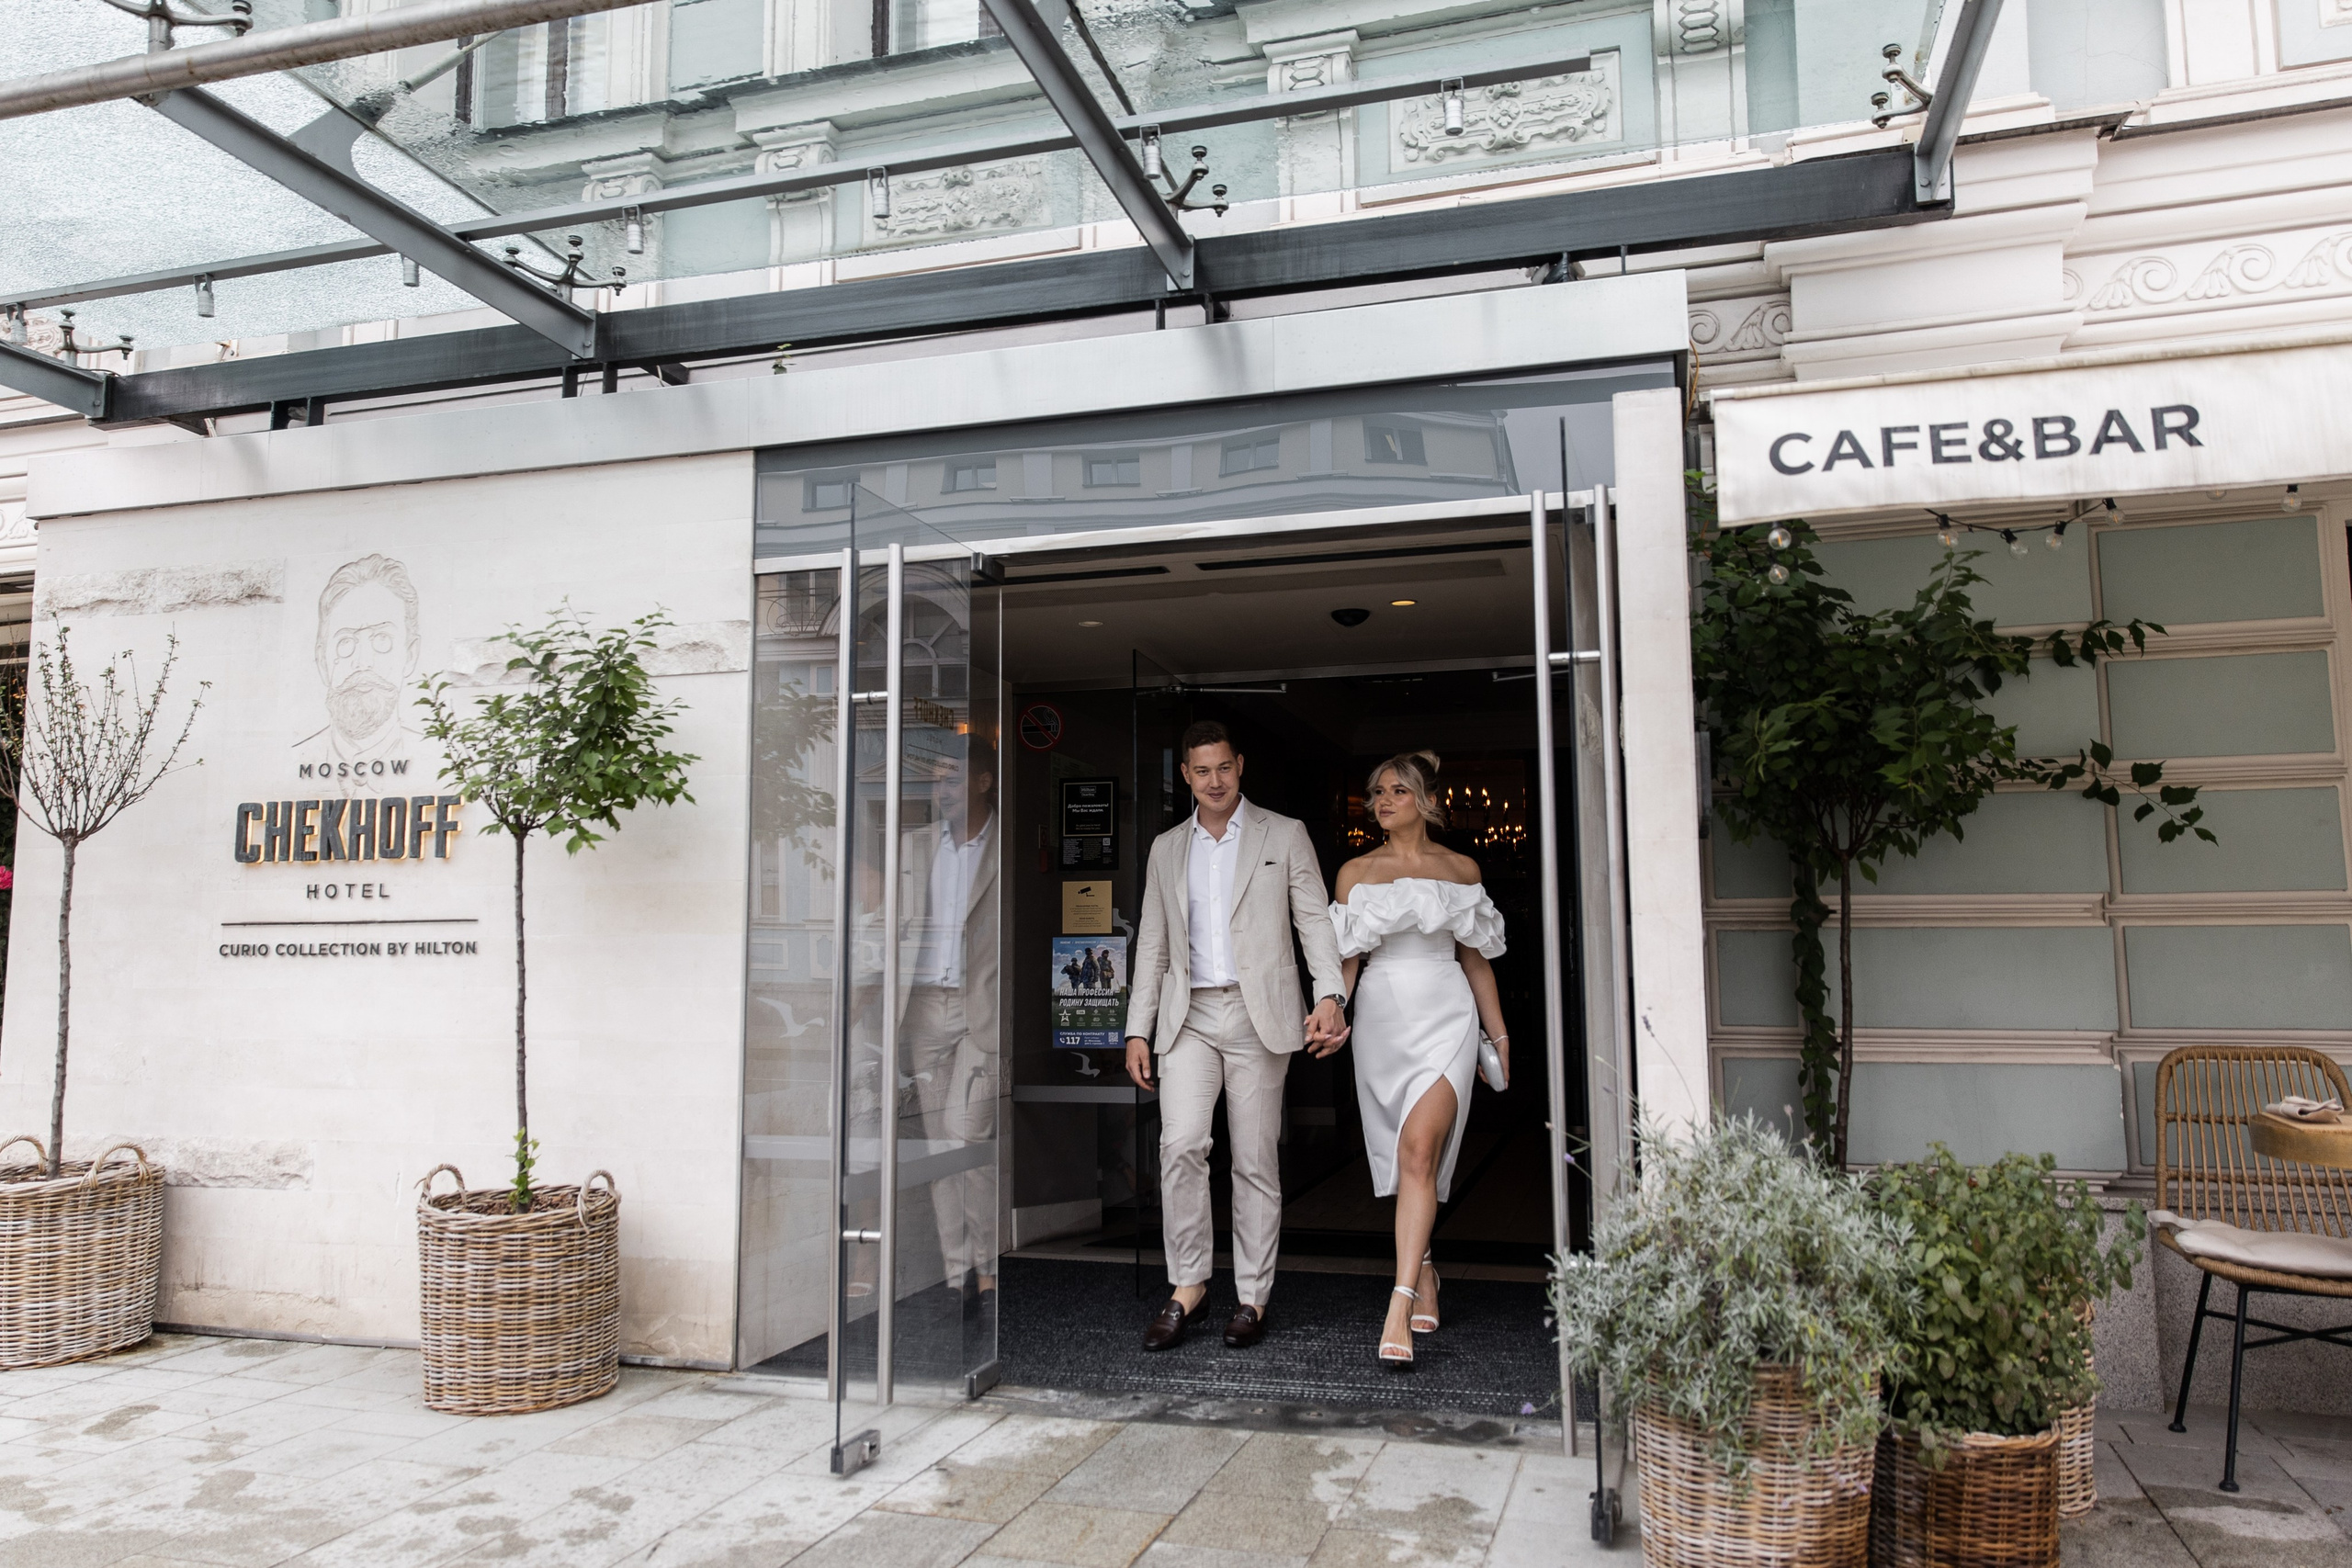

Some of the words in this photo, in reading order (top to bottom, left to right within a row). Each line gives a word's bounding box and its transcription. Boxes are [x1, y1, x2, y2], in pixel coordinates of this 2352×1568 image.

[1769, 403, 2205, 477] CAFE&BAR
[299, 760, 410, 779] MOSCOW
[234, 795, 464, 863] CHEKHOFF
[306, 883, 390, 899] HOTEL
[219, 943, 269, 956] CURIO
[276, 942, 379, 956] COLLECTION
[387, 942, 408, 955] BY
[414, 942, 477, 954] HILTON
[1059, 988, 1077, 997] НАША
[1078, 987, 1114, 997] ПРОФЕССИЯ
[1058, 998, 1084, 1007] РОДИНУ
[1084, 998, 1119, 1007] ЗАЩИЩАТЬ
[1066, 1036, 1080, 1044] 117
